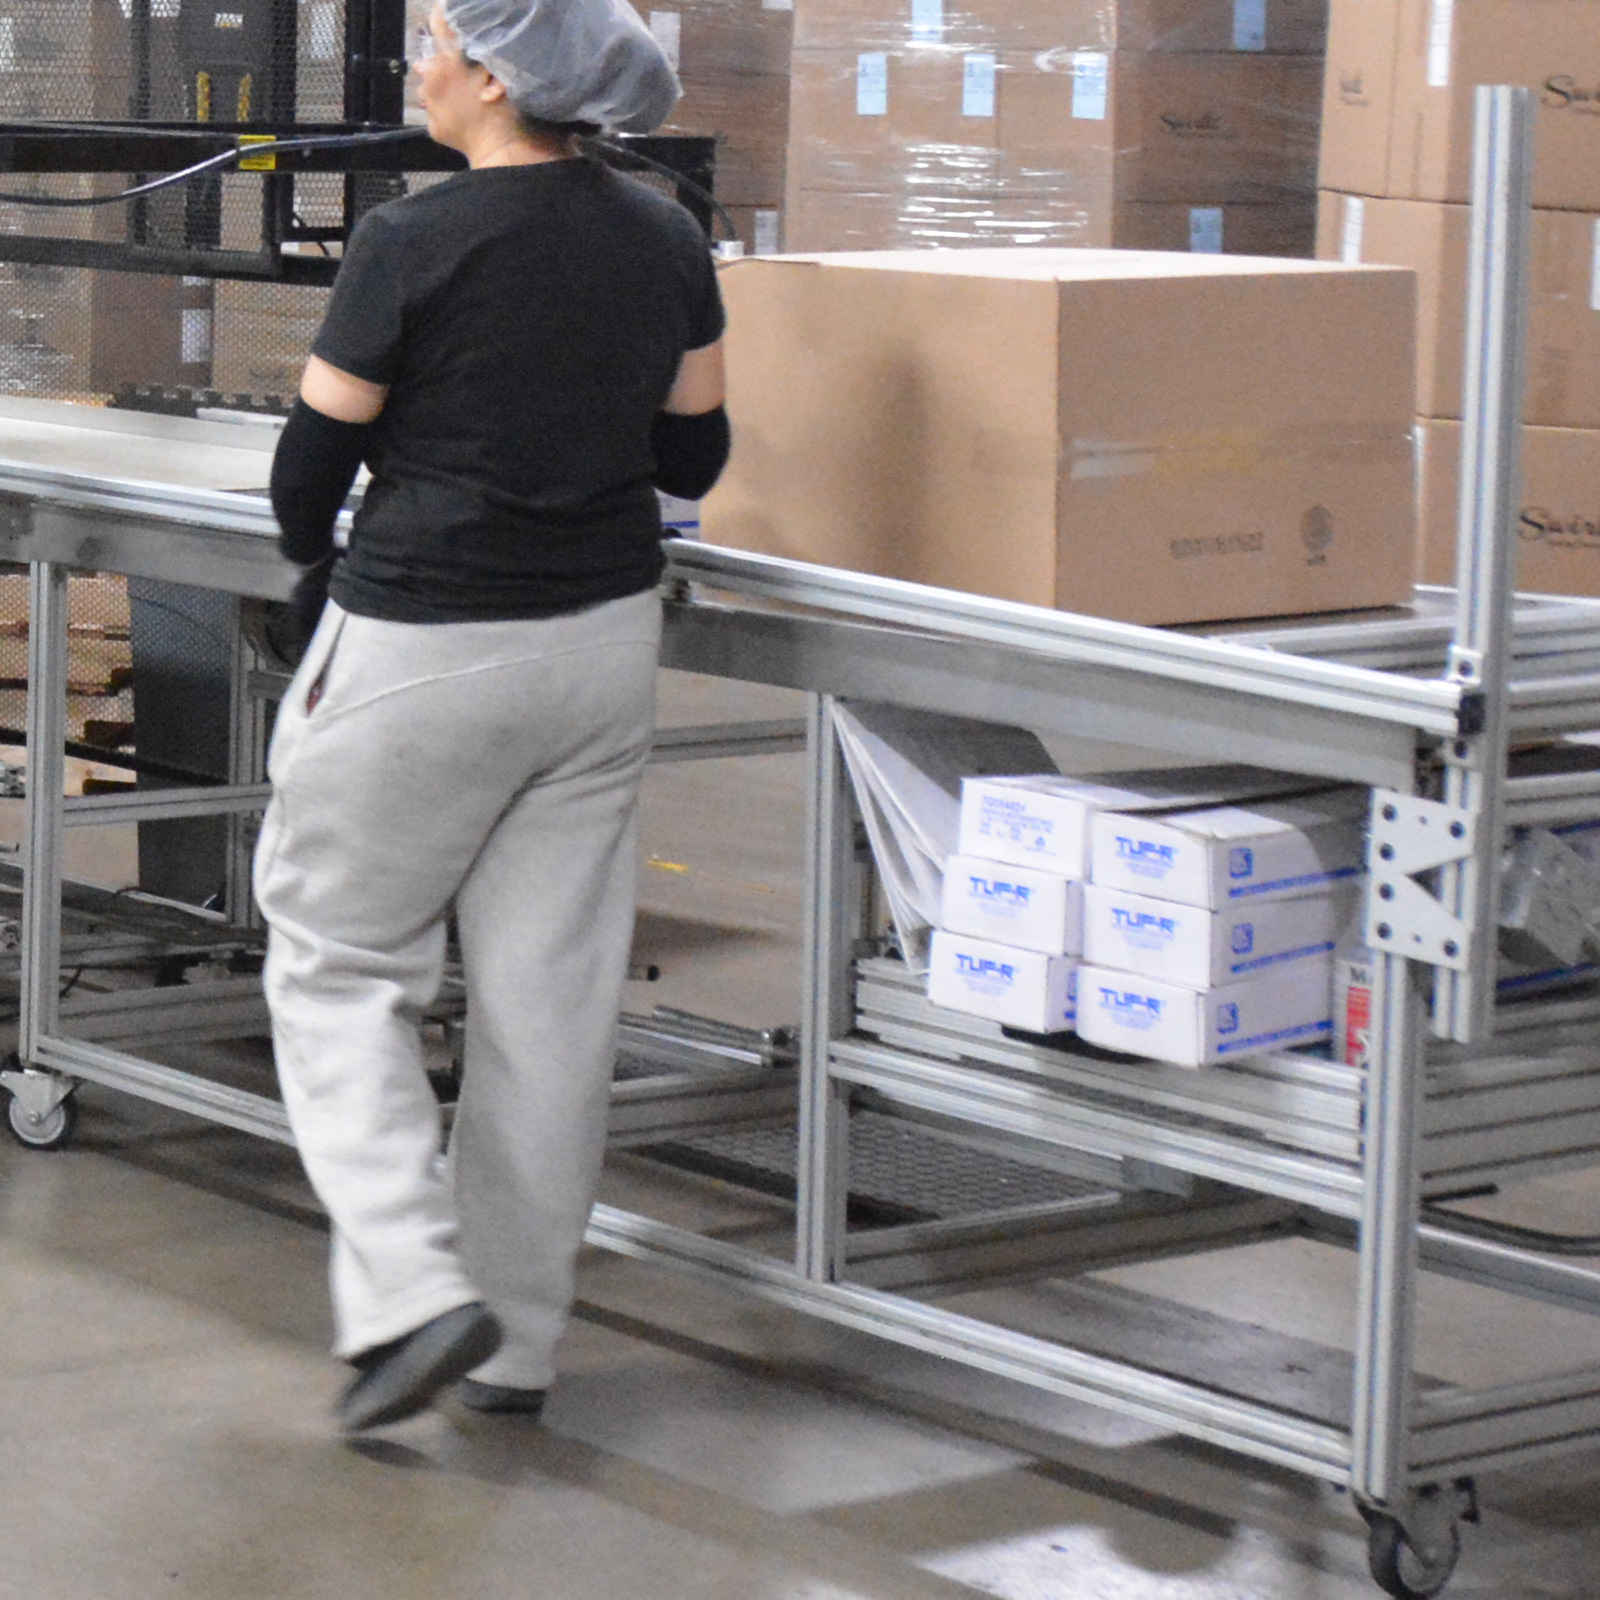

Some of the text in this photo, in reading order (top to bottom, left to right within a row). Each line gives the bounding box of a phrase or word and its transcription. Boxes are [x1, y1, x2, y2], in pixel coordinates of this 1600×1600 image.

[969, 876, 1031, 902] TUF-R
[1112, 908, 1175, 934] TUF-R
[955, 952, 1015, 982] TUF-R
[1099, 986, 1162, 1015] TUF-R
